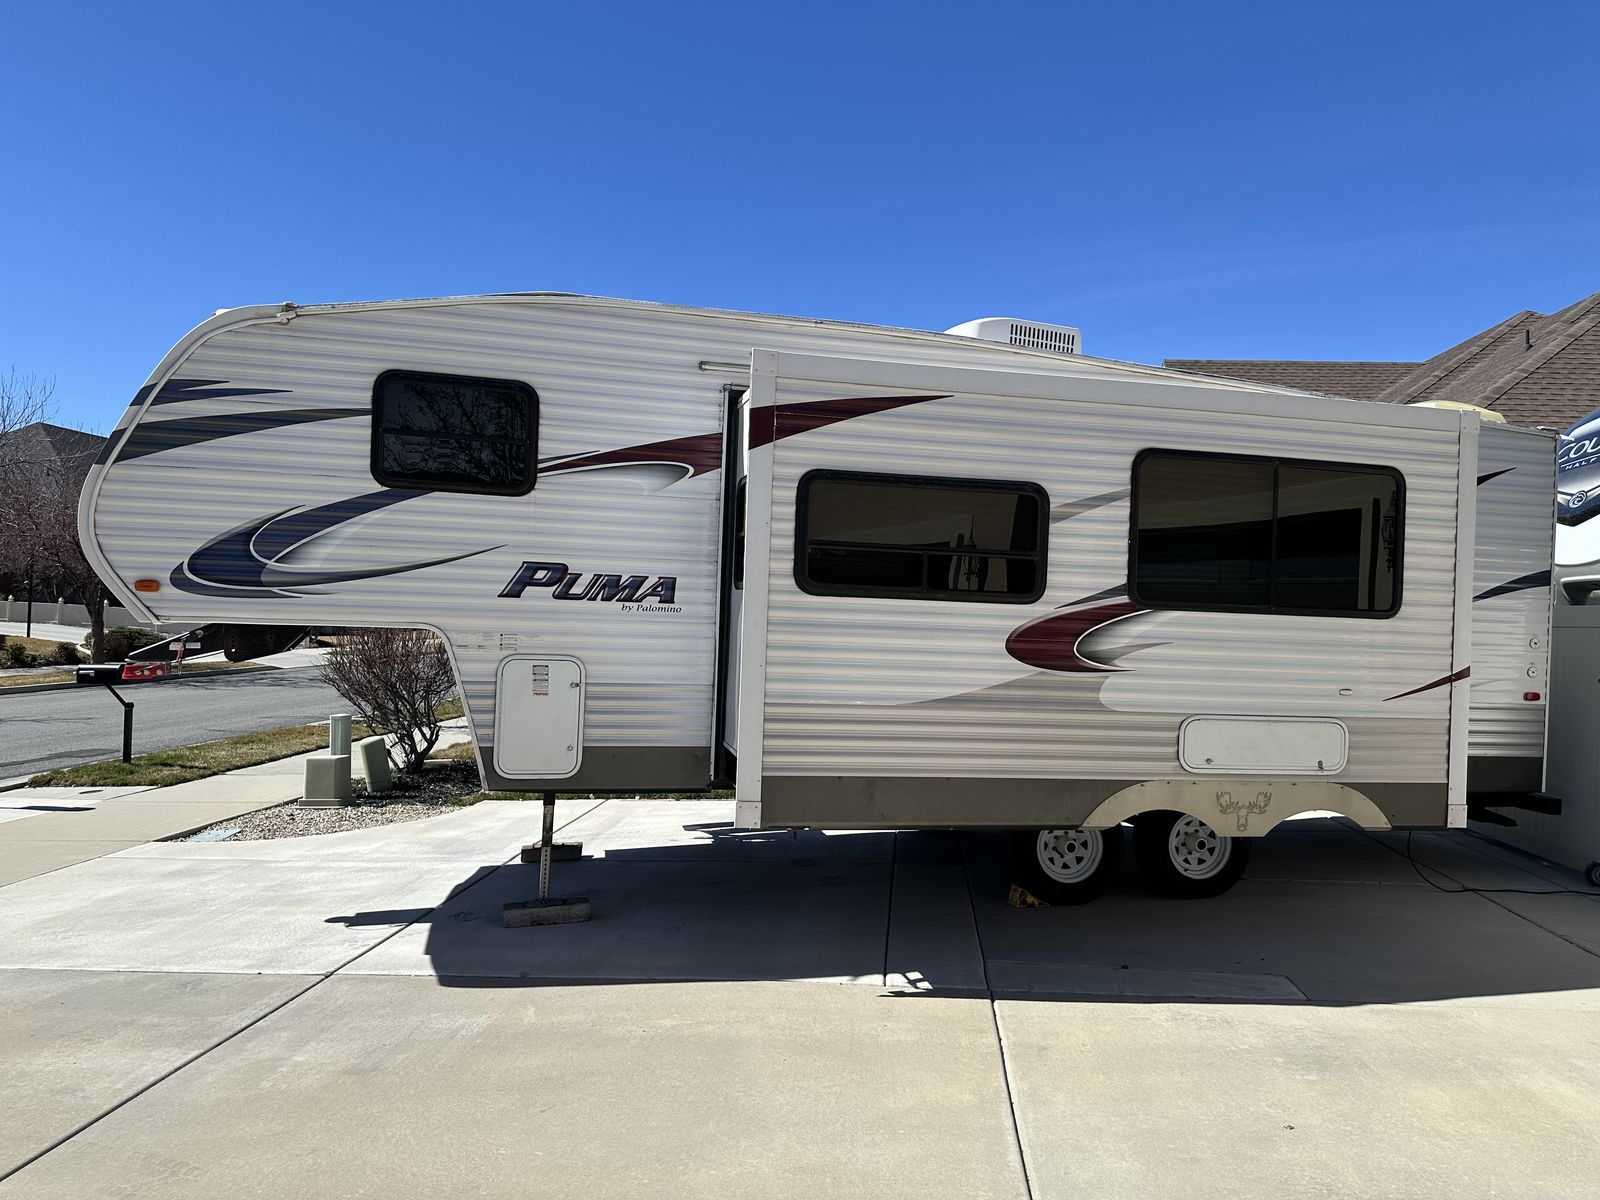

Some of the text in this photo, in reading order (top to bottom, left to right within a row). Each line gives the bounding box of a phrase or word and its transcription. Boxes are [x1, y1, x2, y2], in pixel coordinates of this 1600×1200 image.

[1565, 457, 1597, 470] HALF
[497, 561, 677, 604] PUMA
[621, 603, 682, 613] by Palomino
